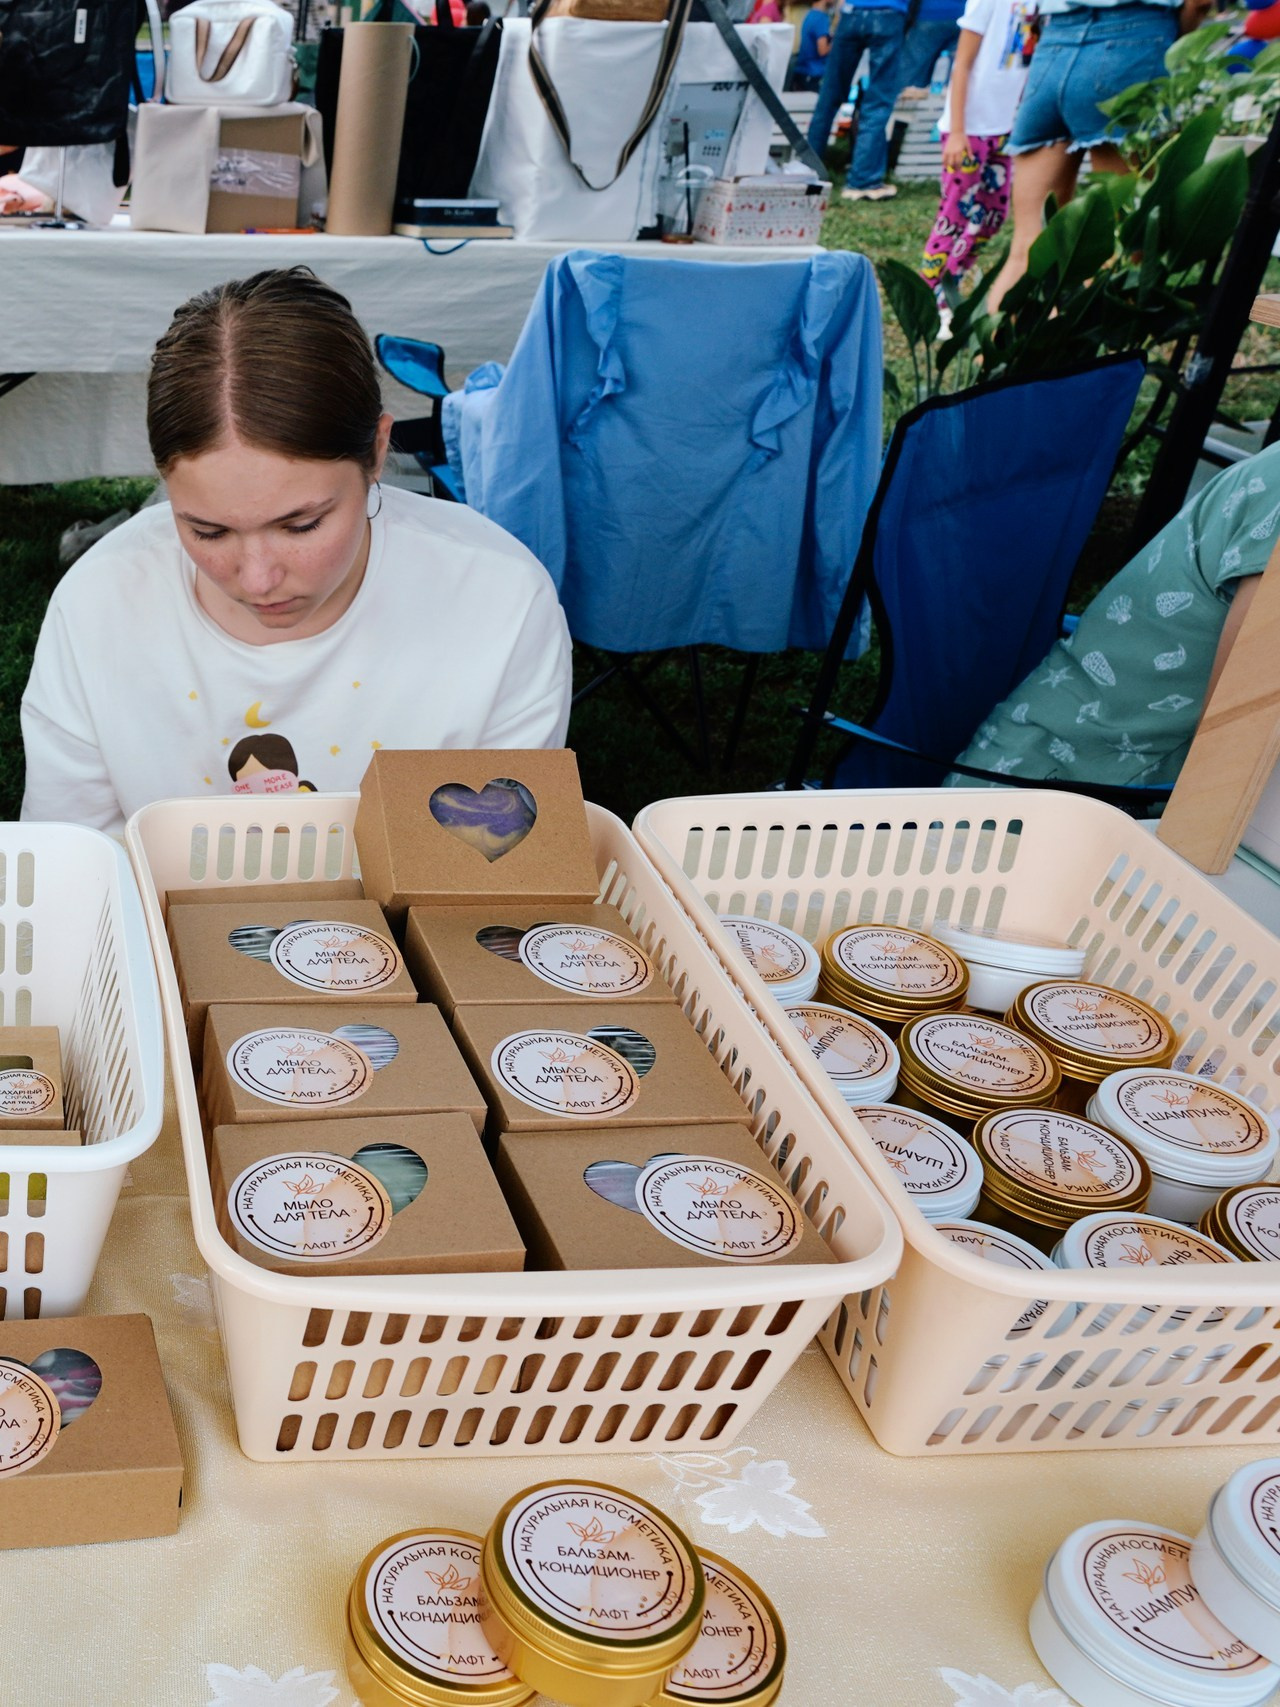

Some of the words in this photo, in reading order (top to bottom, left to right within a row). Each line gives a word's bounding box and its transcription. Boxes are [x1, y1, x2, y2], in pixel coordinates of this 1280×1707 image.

[263, 773, 287, 784] MORE
[234, 783, 251, 793] ONE
[265, 781, 293, 793] PLEASE
[282, 927, 331, 956] НАТУРАЛЬНАЯ
[333, 927, 388, 956] КОСМЕТИКА
[531, 929, 573, 959] НАТУРАЛЬНАЯ
[575, 930, 636, 959] КОСМЕТИКА
[740, 924, 800, 957] НАТУРАЛЬНАЯ
[844, 932, 884, 960] НАТУРАЛЬНАЯ
[886, 933, 946, 962] КОСМЕТИКА
[306, 958, 333, 966] ДЛЯ
[560, 961, 586, 969] ДЛЯ
[1037, 988, 1070, 1023] НАТУРАЛЬНАЯ
[1070, 988, 1142, 1016] КОСМЕТИКА
[788, 1011, 843, 1024] СМЕТИКА
[1062, 1020, 1140, 1031] КОНДИЦИОНЕР
[240, 1033, 296, 1065] НАТУРАЛЬНАЯ
[298, 1034, 358, 1066] КОСМЕТИКА
[811, 1026, 845, 1060] АМПУНЬ
[924, 1021, 993, 1038] НАТУРАЛЬНАЯ
[995, 1029, 1039, 1072] КОСМЕТИКА
[1111, 1042, 1138, 1050] ЛАФТ
[505, 1036, 554, 1073] НАТУРАЛЬНАЯ
[556, 1037, 621, 1073] КОСМЕТИКА
[932, 1042, 1025, 1076] КОНДИЦИОНЕР
[951, 1040, 1010, 1063] БАЛЬЗАМ-
[541, 1066, 586, 1074] МЫЛО
[862, 1054, 878, 1071] ЛАФТ
[266, 1067, 296, 1076] ДЛЯ
[298, 1067, 336, 1075] ТЕЛА
[535, 1075, 564, 1084] ДЛЯ
[568, 1075, 604, 1083] ТЕЛА
[955, 1071, 989, 1084] ЛАФТ
[1123, 1079, 1157, 1117] НАТУРАЛЬНАЯ
[1159, 1079, 1238, 1111] КОСМЕТИКА
[1146, 1107, 1231, 1122] ШАМПУНЬ
[891, 1117, 925, 1131] ЛАФТ
[999, 1132, 1011, 1153] ЛАФТ
[1056, 1120, 1127, 1172] НАТУРАЛЬНАЯ
[1208, 1140, 1238, 1149] ЛАФТ
[875, 1140, 944, 1170] ШАМПУ
[1039, 1123, 1056, 1179] КОНДИЦИОНЕР
[243, 1161, 302, 1210] НАТУРАЛЬНАЯ
[305, 1161, 374, 1203] КОСМЕТИКА
[650, 1164, 701, 1207] НАТУРАЛЬНАЯ
[704, 1165, 780, 1208] КОСМЕТИКА
[1065, 1168, 1126, 1194] КОСМЕТИКА
[283, 1198, 334, 1211] МЫЛО
[692, 1200, 742, 1209] МЫЛО
[273, 1211, 306, 1224] ДЛЯ
[307, 1208, 350, 1220] ТЕЛА
[687, 1210, 719, 1220] ДЛЯ
[719, 1210, 763, 1220] ТЕЛА
[951, 1234, 985, 1246] ЛАФТ
[1107, 1226, 1190, 1248] КОСМЕТИКА
[302, 1241, 338, 1250] ЛАФТ
[723, 1241, 757, 1250] ЛАФТ
[520, 1498, 590, 1552] НАТУРАЛЬНАЯ
[594, 1500, 673, 1565] КОСМЕТИКА
[557, 1546, 635, 1562] БАЛЬЗАМ-
[382, 1546, 447, 1604] НАТУРАЛЬНАЯ
[538, 1561, 661, 1581] КОНДИЦИОНЕР
[1093, 1543, 1129, 1622] НАТУРАЛЬНАЯ
[1118, 1539, 1188, 1560] КОСМЕТ
[704, 1572, 752, 1620] МЕТИКА
[589, 1608, 630, 1620] ЛАФТ
[448, 1654, 486, 1665] ЛАФТ
[683, 1668, 720, 1679] ЛАФТ
